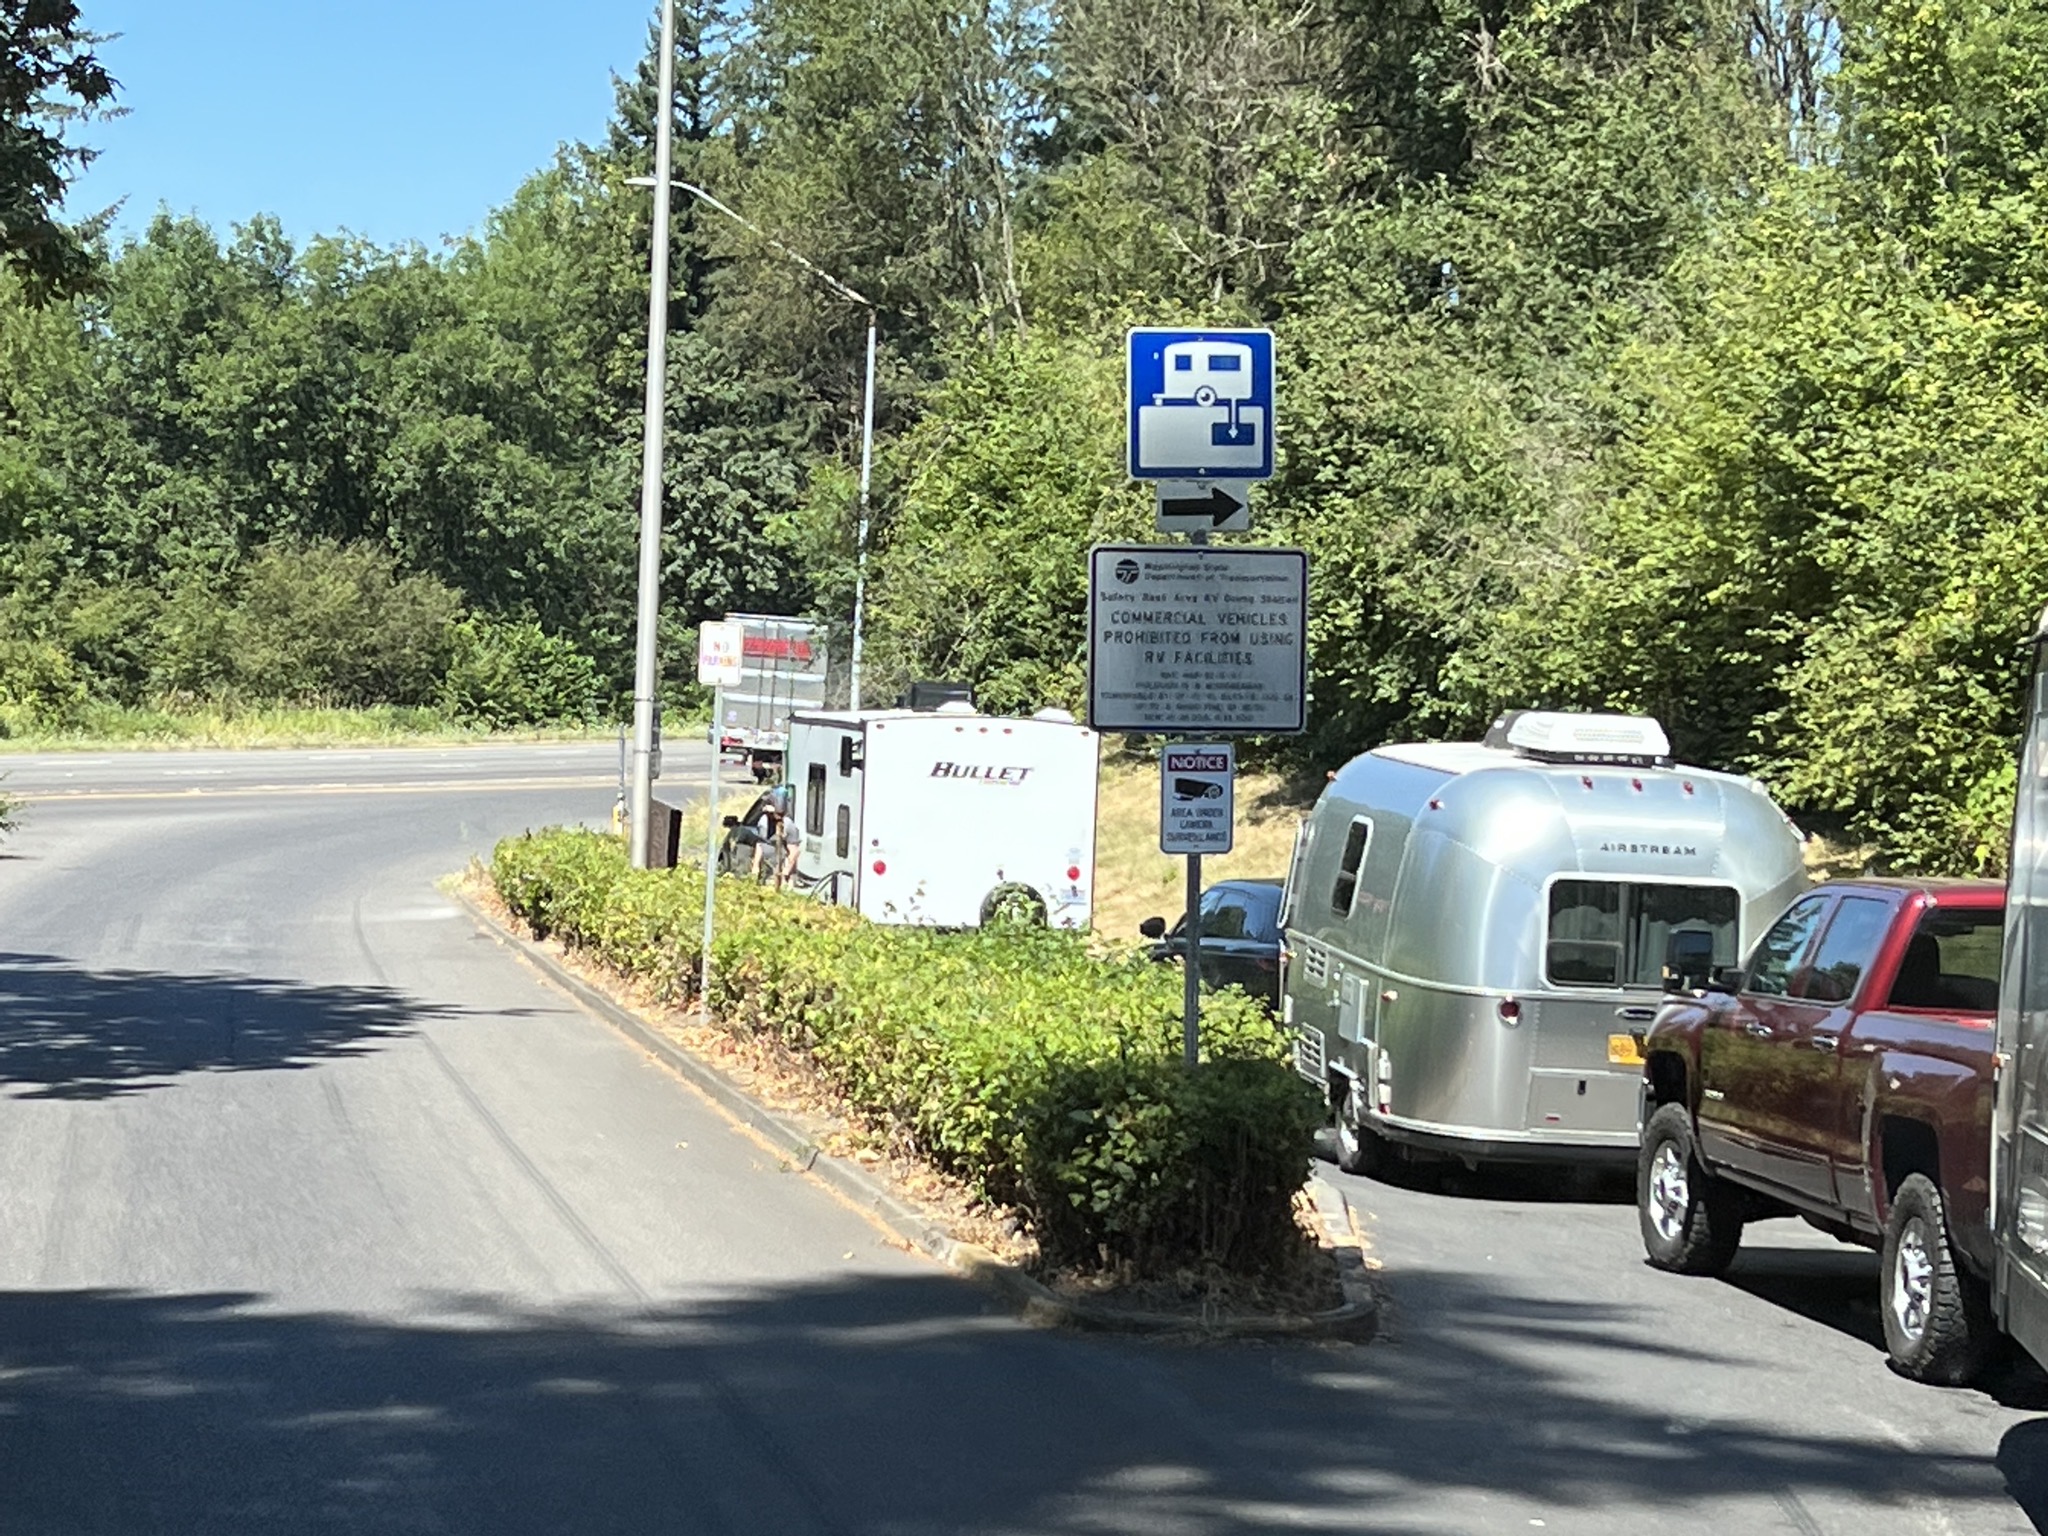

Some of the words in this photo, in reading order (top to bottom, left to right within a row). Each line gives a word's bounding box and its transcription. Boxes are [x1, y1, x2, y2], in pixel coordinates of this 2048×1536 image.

[1110, 611, 1206, 625] COMMERCIAL
[1217, 612, 1289, 626] VEHICLES
[1103, 630, 1191, 645] PROHIBITED
[1200, 631, 1240, 645] FROM
[1249, 632, 1294, 646] USING
[713, 641, 730, 653] NO
[1144, 650, 1166, 664] RV
[1174, 651, 1254, 665] FACILITIES
[1171, 756, 1224, 770] NOTICE
[928, 761, 1034, 782] BULLET
[1171, 807, 1193, 818] AREA
[1600, 843, 1697, 856] AIRSTREAM
